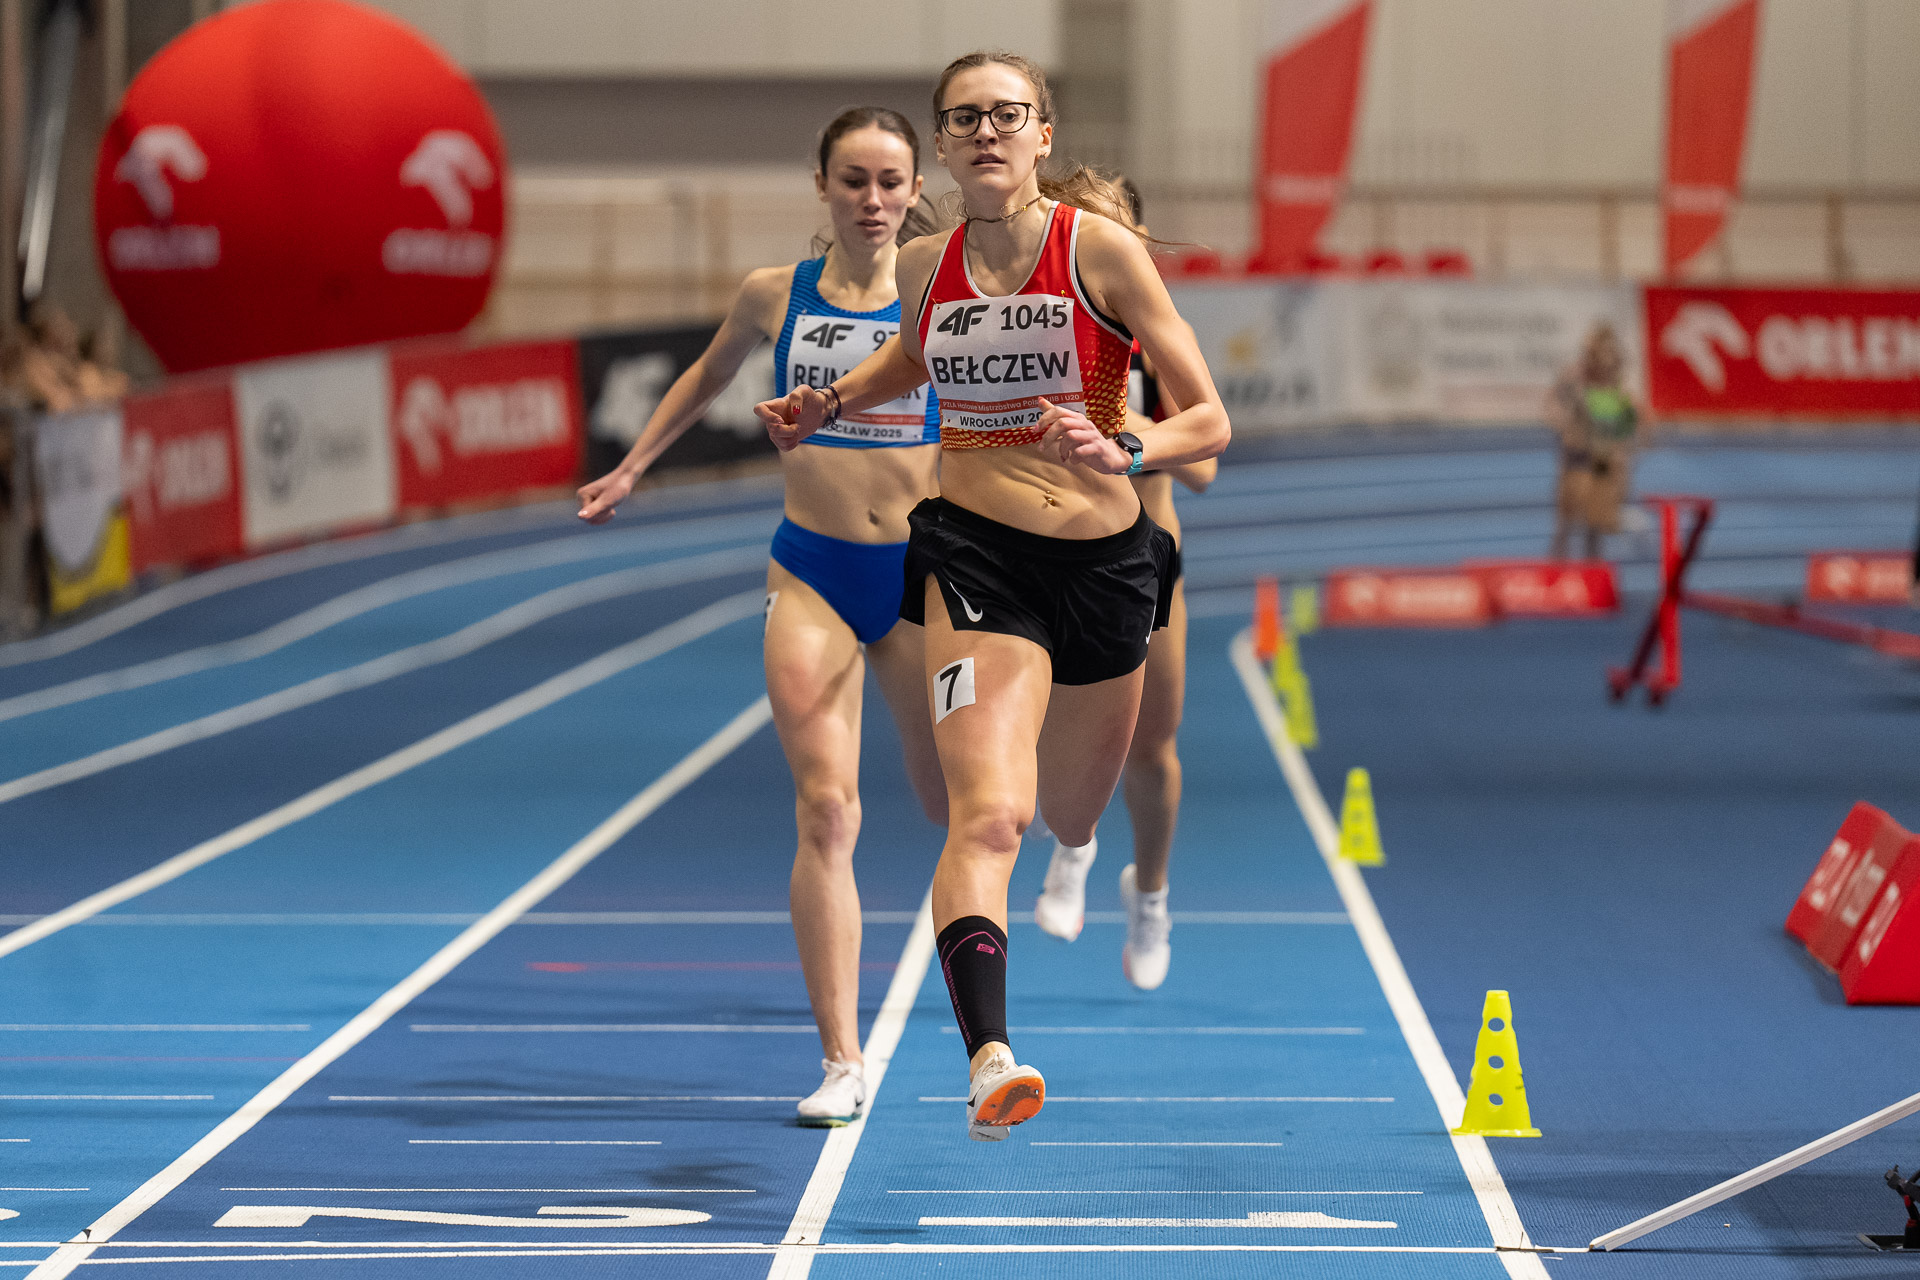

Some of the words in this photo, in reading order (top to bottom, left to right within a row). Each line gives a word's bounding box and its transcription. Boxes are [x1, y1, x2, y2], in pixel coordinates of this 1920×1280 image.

[936, 304, 991, 336] 4F
[1000, 304, 1068, 330] 1045
[802, 323, 855, 348] 4F
[931, 351, 1070, 384] BEŁCZEW
[957, 402, 977, 411] Halowe
[978, 401, 1021, 412] Mistrzostwa
[873, 428, 902, 438] 2025
[960, 414, 1025, 428] WROCŁAW
[939, 663, 963, 712] 7
